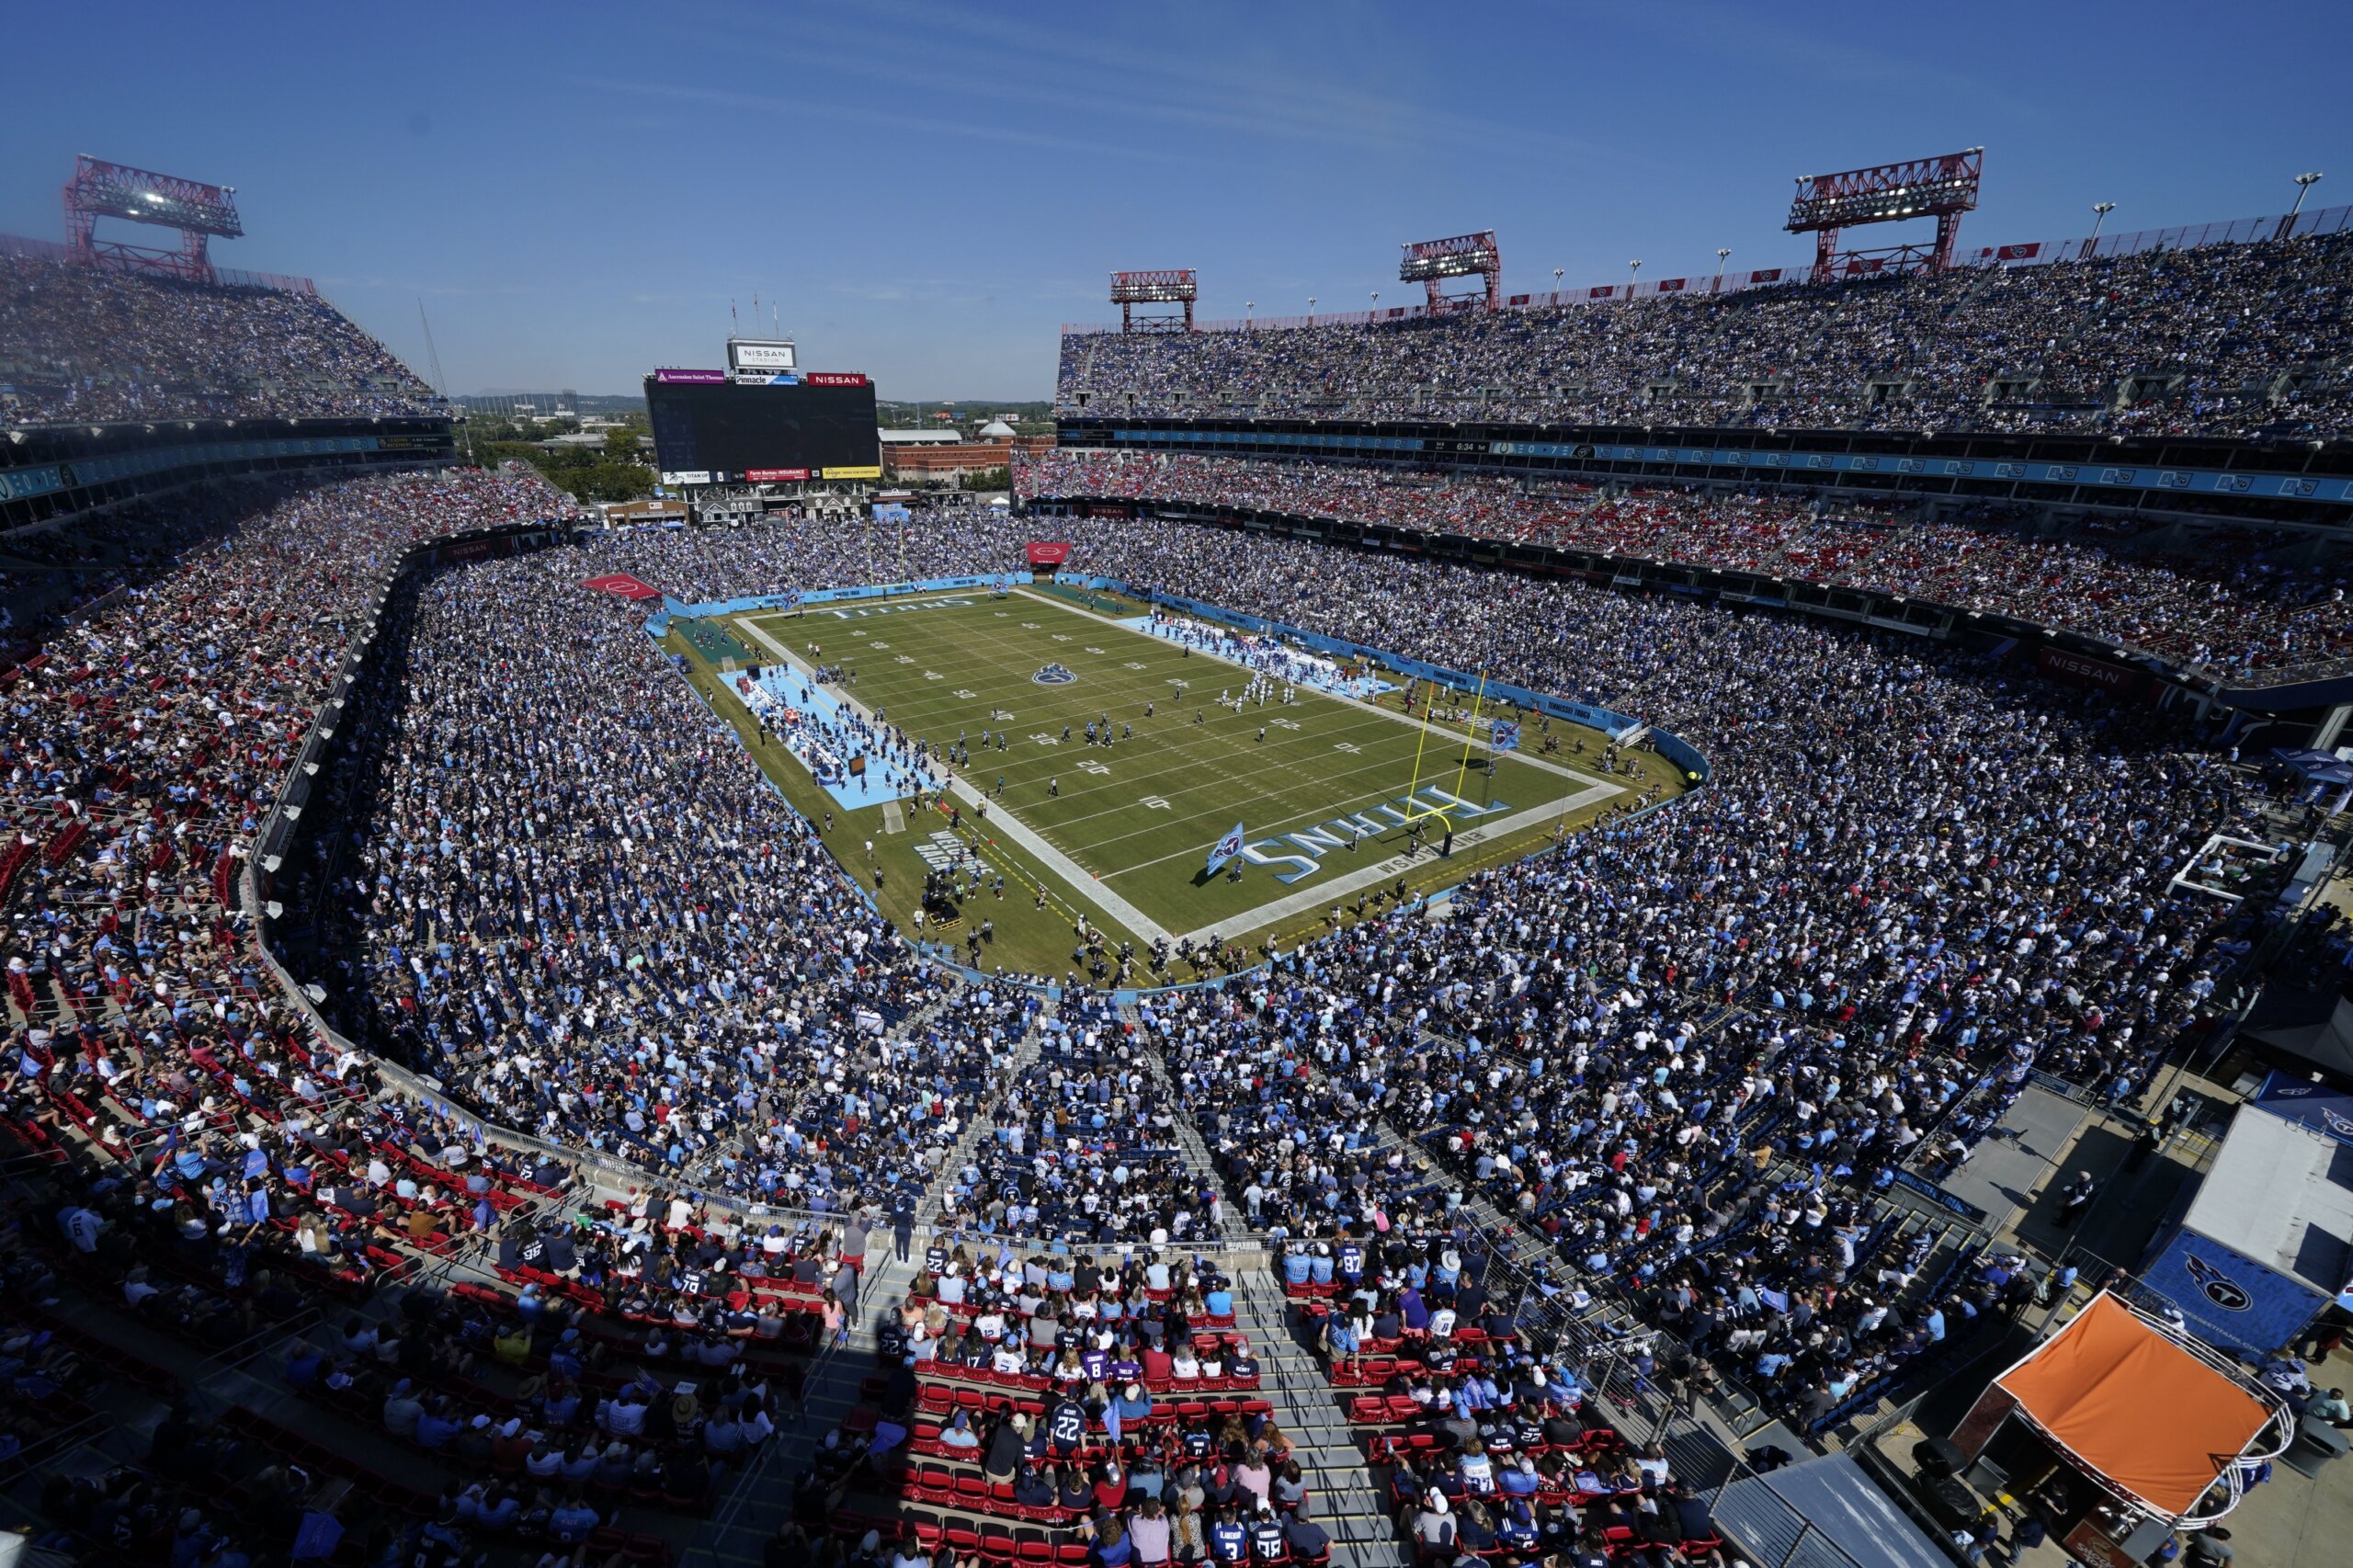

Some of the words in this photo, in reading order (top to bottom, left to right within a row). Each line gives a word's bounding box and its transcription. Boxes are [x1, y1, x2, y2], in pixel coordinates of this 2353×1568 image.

[453, 544, 486, 555] NISSAN
[819, 597, 976, 620] TITANS
[2049, 655, 2119, 684] NISSAN
[952, 689, 977, 699] 50
[1548, 701, 1573, 714] TENNESSEE
[1575, 709, 1591, 719] TOUGH
[1270, 718, 1301, 730] 20
[1029, 733, 1058, 745] 30
[1334, 742, 1361, 755] 10
[1076, 760, 1111, 775] 20
[1139, 795, 1171, 810] 10
[1241, 783, 1514, 885] TITANS
[1452, 832, 1487, 847] END
[877, 1159, 882, 1168] 8
[765, 1177, 771, 1186] 7
[927, 1258, 943, 1273] 22
[1344, 1256, 1360, 1273] 87
[1293, 1267, 1305, 1278] 17
[1316, 1267, 1328, 1280] 17
[682, 1281, 699, 1294] 79
[1727, 1305, 1743, 1318] 77
[1441, 1323, 1448, 1332] 8
[882, 1341, 900, 1354] 22
[1092, 1363, 1101, 1377] 8
[1056, 1417, 1079, 1441] 22
[1521, 1432, 1542, 1442] 22
[1471, 1477, 1491, 1492] 27
[1257, 1530, 1279, 1539] SIMMONS
[1225, 1543, 1238, 1560] 3
[1256, 1541, 1280, 1559] 98
[2076, 1543, 2115, 1567] SHOCK
